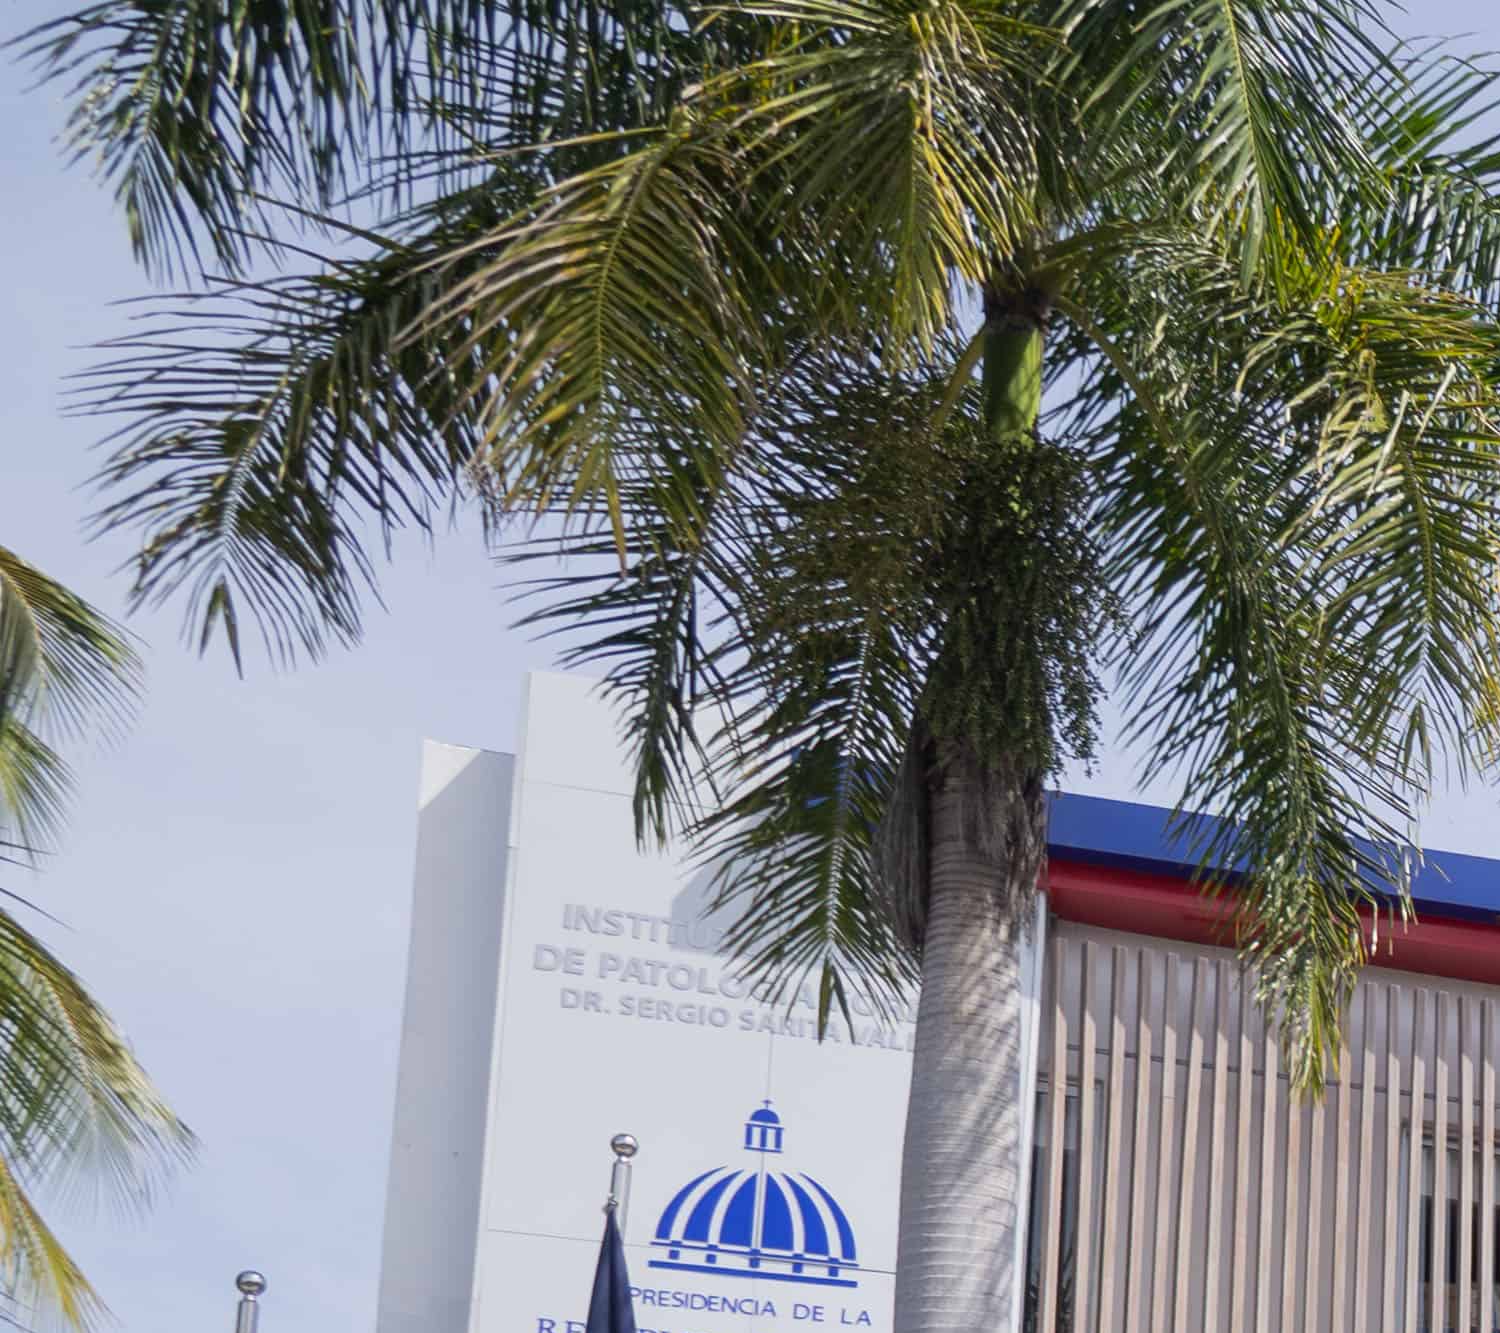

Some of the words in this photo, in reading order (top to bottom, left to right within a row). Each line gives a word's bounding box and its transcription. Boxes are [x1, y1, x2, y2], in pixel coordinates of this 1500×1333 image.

[562, 903, 732, 957] INSTITU
[532, 944, 586, 976] DE
[560, 987, 611, 1015] DR.
[619, 994, 731, 1029] SERGIO
[629, 1287, 777, 1318] PRESIDENCIA
[792, 1304, 825, 1322] DE
[841, 1308, 873, 1327] LA
